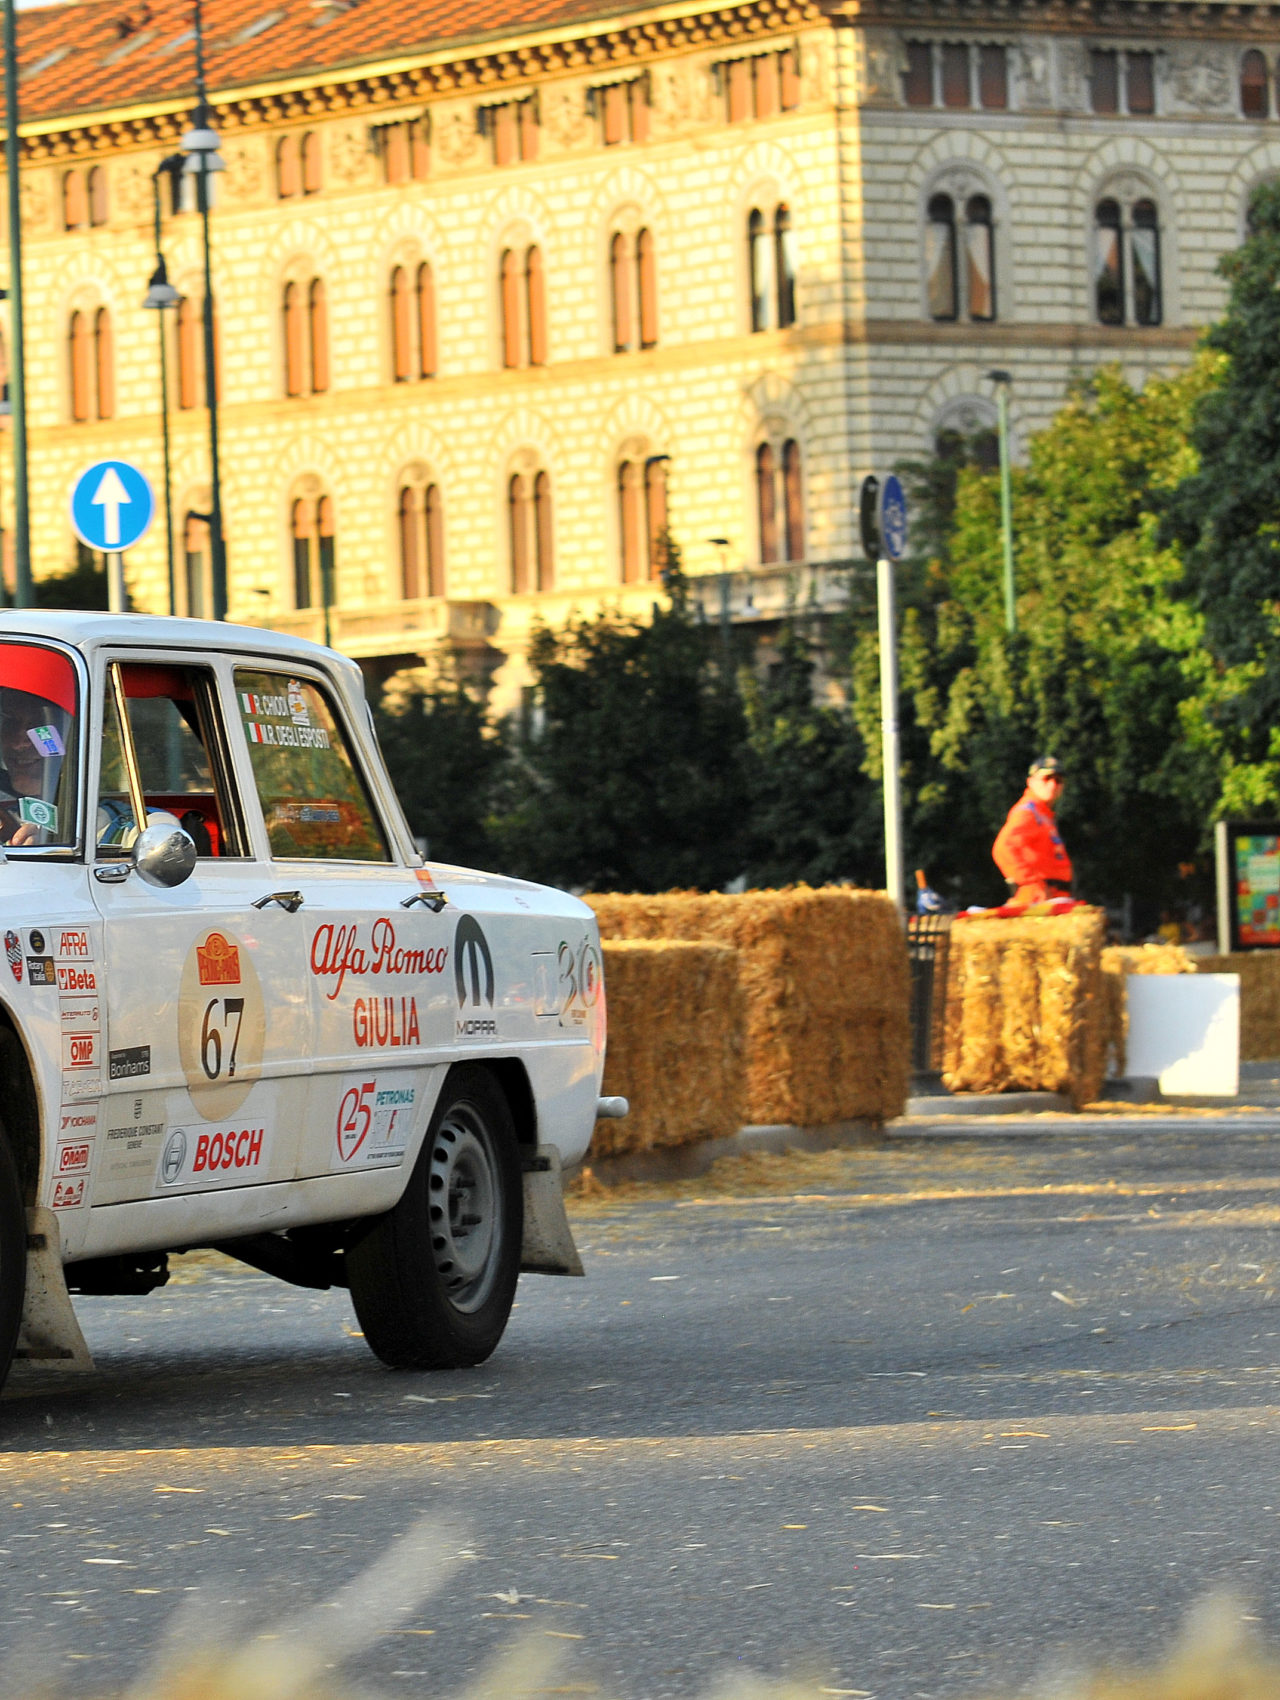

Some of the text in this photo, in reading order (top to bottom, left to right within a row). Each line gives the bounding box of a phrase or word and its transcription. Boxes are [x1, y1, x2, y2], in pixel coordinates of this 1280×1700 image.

[60, 932, 88, 956] AFRA
[310, 917, 448, 1000] Alfa Romeo
[69, 968, 96, 990] Beta
[353, 997, 421, 1047] GIULIA
[456, 1020, 496, 1036] MOPAR
[70, 1040, 93, 1061] OMP
[200, 998, 245, 1080] 67
[110, 1058, 150, 1078] Bonhams
[376, 1088, 415, 1106] PETRONAS
[337, 1078, 376, 1162] 25
[192, 1129, 264, 1172] BOSCH
